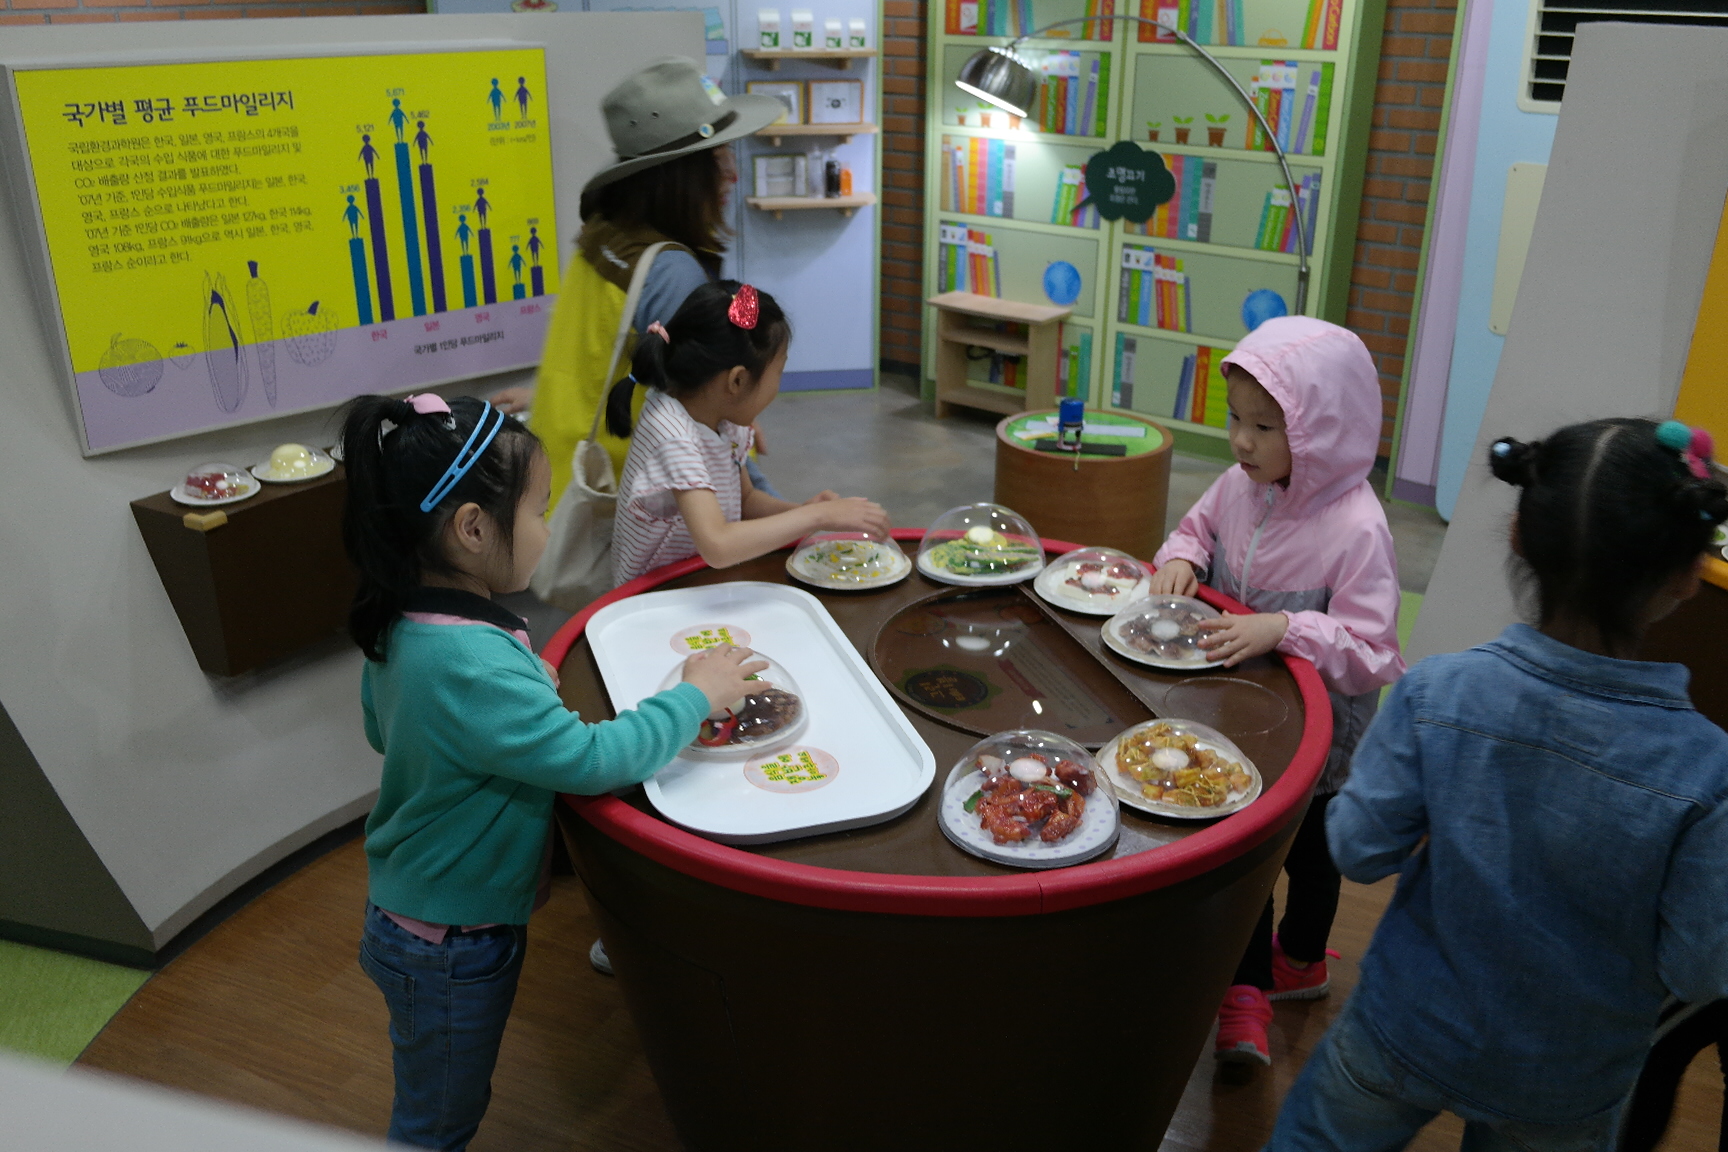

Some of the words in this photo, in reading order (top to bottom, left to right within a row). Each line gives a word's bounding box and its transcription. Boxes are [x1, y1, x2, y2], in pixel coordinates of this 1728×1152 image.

[62, 100, 128, 128] 국가별
[133, 97, 175, 124] 평균
[182, 90, 294, 118] 푸드마일리지
[68, 136, 151, 154] 국립환경과학원은
[228, 128, 265, 142] 프랑스의
[267, 125, 299, 138] 4개국을
[71, 157, 116, 172] 대상으로
[119, 154, 151, 167] 각국의
[154, 152, 175, 165] 수입
[178, 150, 207, 162] 식품에
[210, 147, 230, 160] 대한
[233, 143, 289, 158] 푸드마일리지
[292, 142, 302, 153] 및
[97, 173, 130, 187] 배출량
[134, 171, 154, 184] 산정
[158, 168, 187, 182] 결과를
[190, 163, 241, 179] 발표하였다.
[131, 188, 155, 201] 1인당
[158, 183, 196, 198] 수입식품
[199, 178, 263, 194] 푸드마일리지는
[109, 207, 141, 220] 프랑스
[144, 203, 175, 217] 순으로
[177, 198, 226, 212] 나타났다고
[228, 195, 249, 208] 한다.
[135, 221, 158, 235] 1인당
[181, 214, 219, 229] 배출량은
[88, 243, 111, 257] 영국
[147, 236, 178, 249] 프랑스
[223, 228, 244, 240] 역시
[92, 260, 123, 273] 프랑스
[126, 254, 167, 270] 순이라고
[474, 311, 491, 324] 영국
[519, 303, 542, 316] 프랑스
[371, 328, 388, 342] 한국
[424, 320, 440, 333] 일본
[413, 342, 437, 355] 국가별
[439, 338, 458, 351] 1인당
[459, 330, 505, 347] 푸드마일리지
